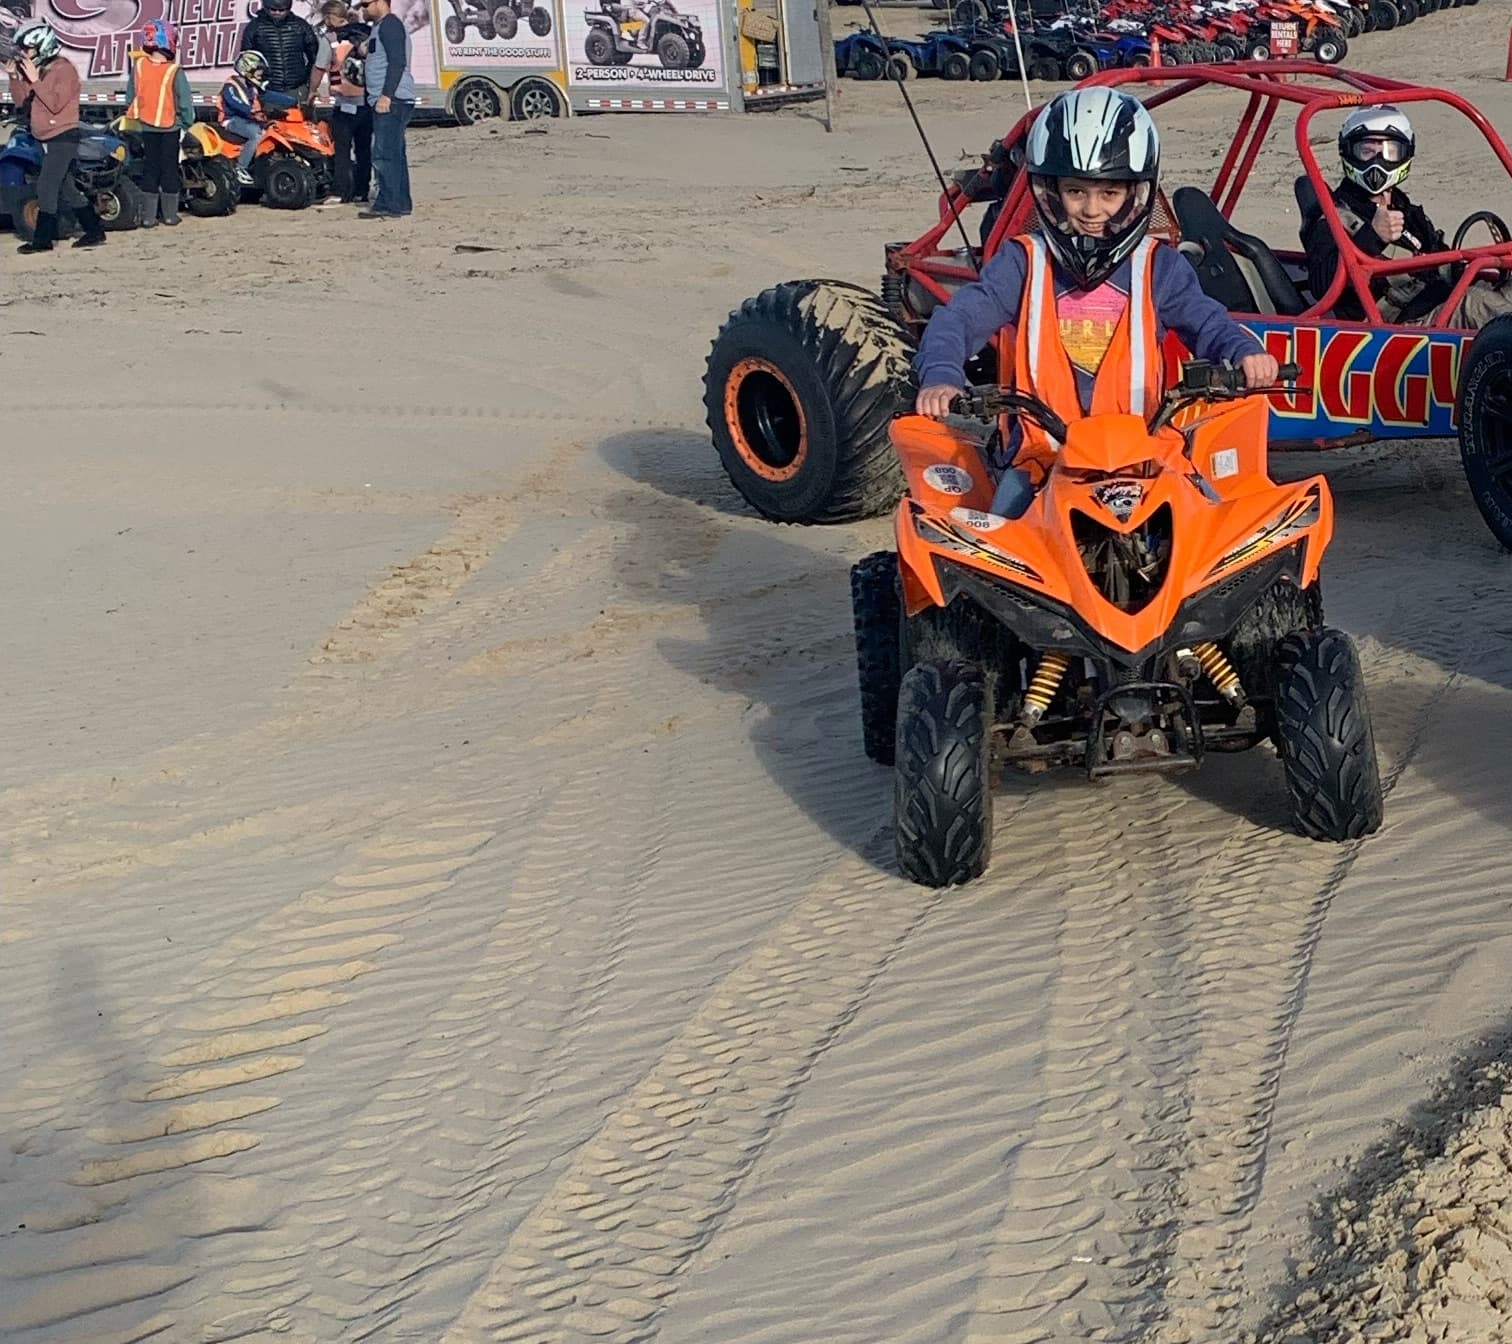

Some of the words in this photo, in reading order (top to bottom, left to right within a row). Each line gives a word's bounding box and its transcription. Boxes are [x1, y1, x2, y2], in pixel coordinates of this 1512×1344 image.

[1271, 22, 1298, 30] RETURN
[1271, 30, 1298, 39] RENTALS
[1276, 39, 1292, 48] HERE
[449, 47, 463, 56] WE
[463, 47, 483, 56] RENT
[483, 47, 498, 57] THE
[499, 47, 525, 57] GOOD
[576, 68, 627, 80] 2-PERSON
[637, 68, 684, 81] 4-WHEEL
[685, 69, 716, 82] DRIVE
[1240, 324, 1476, 429] UGGY
